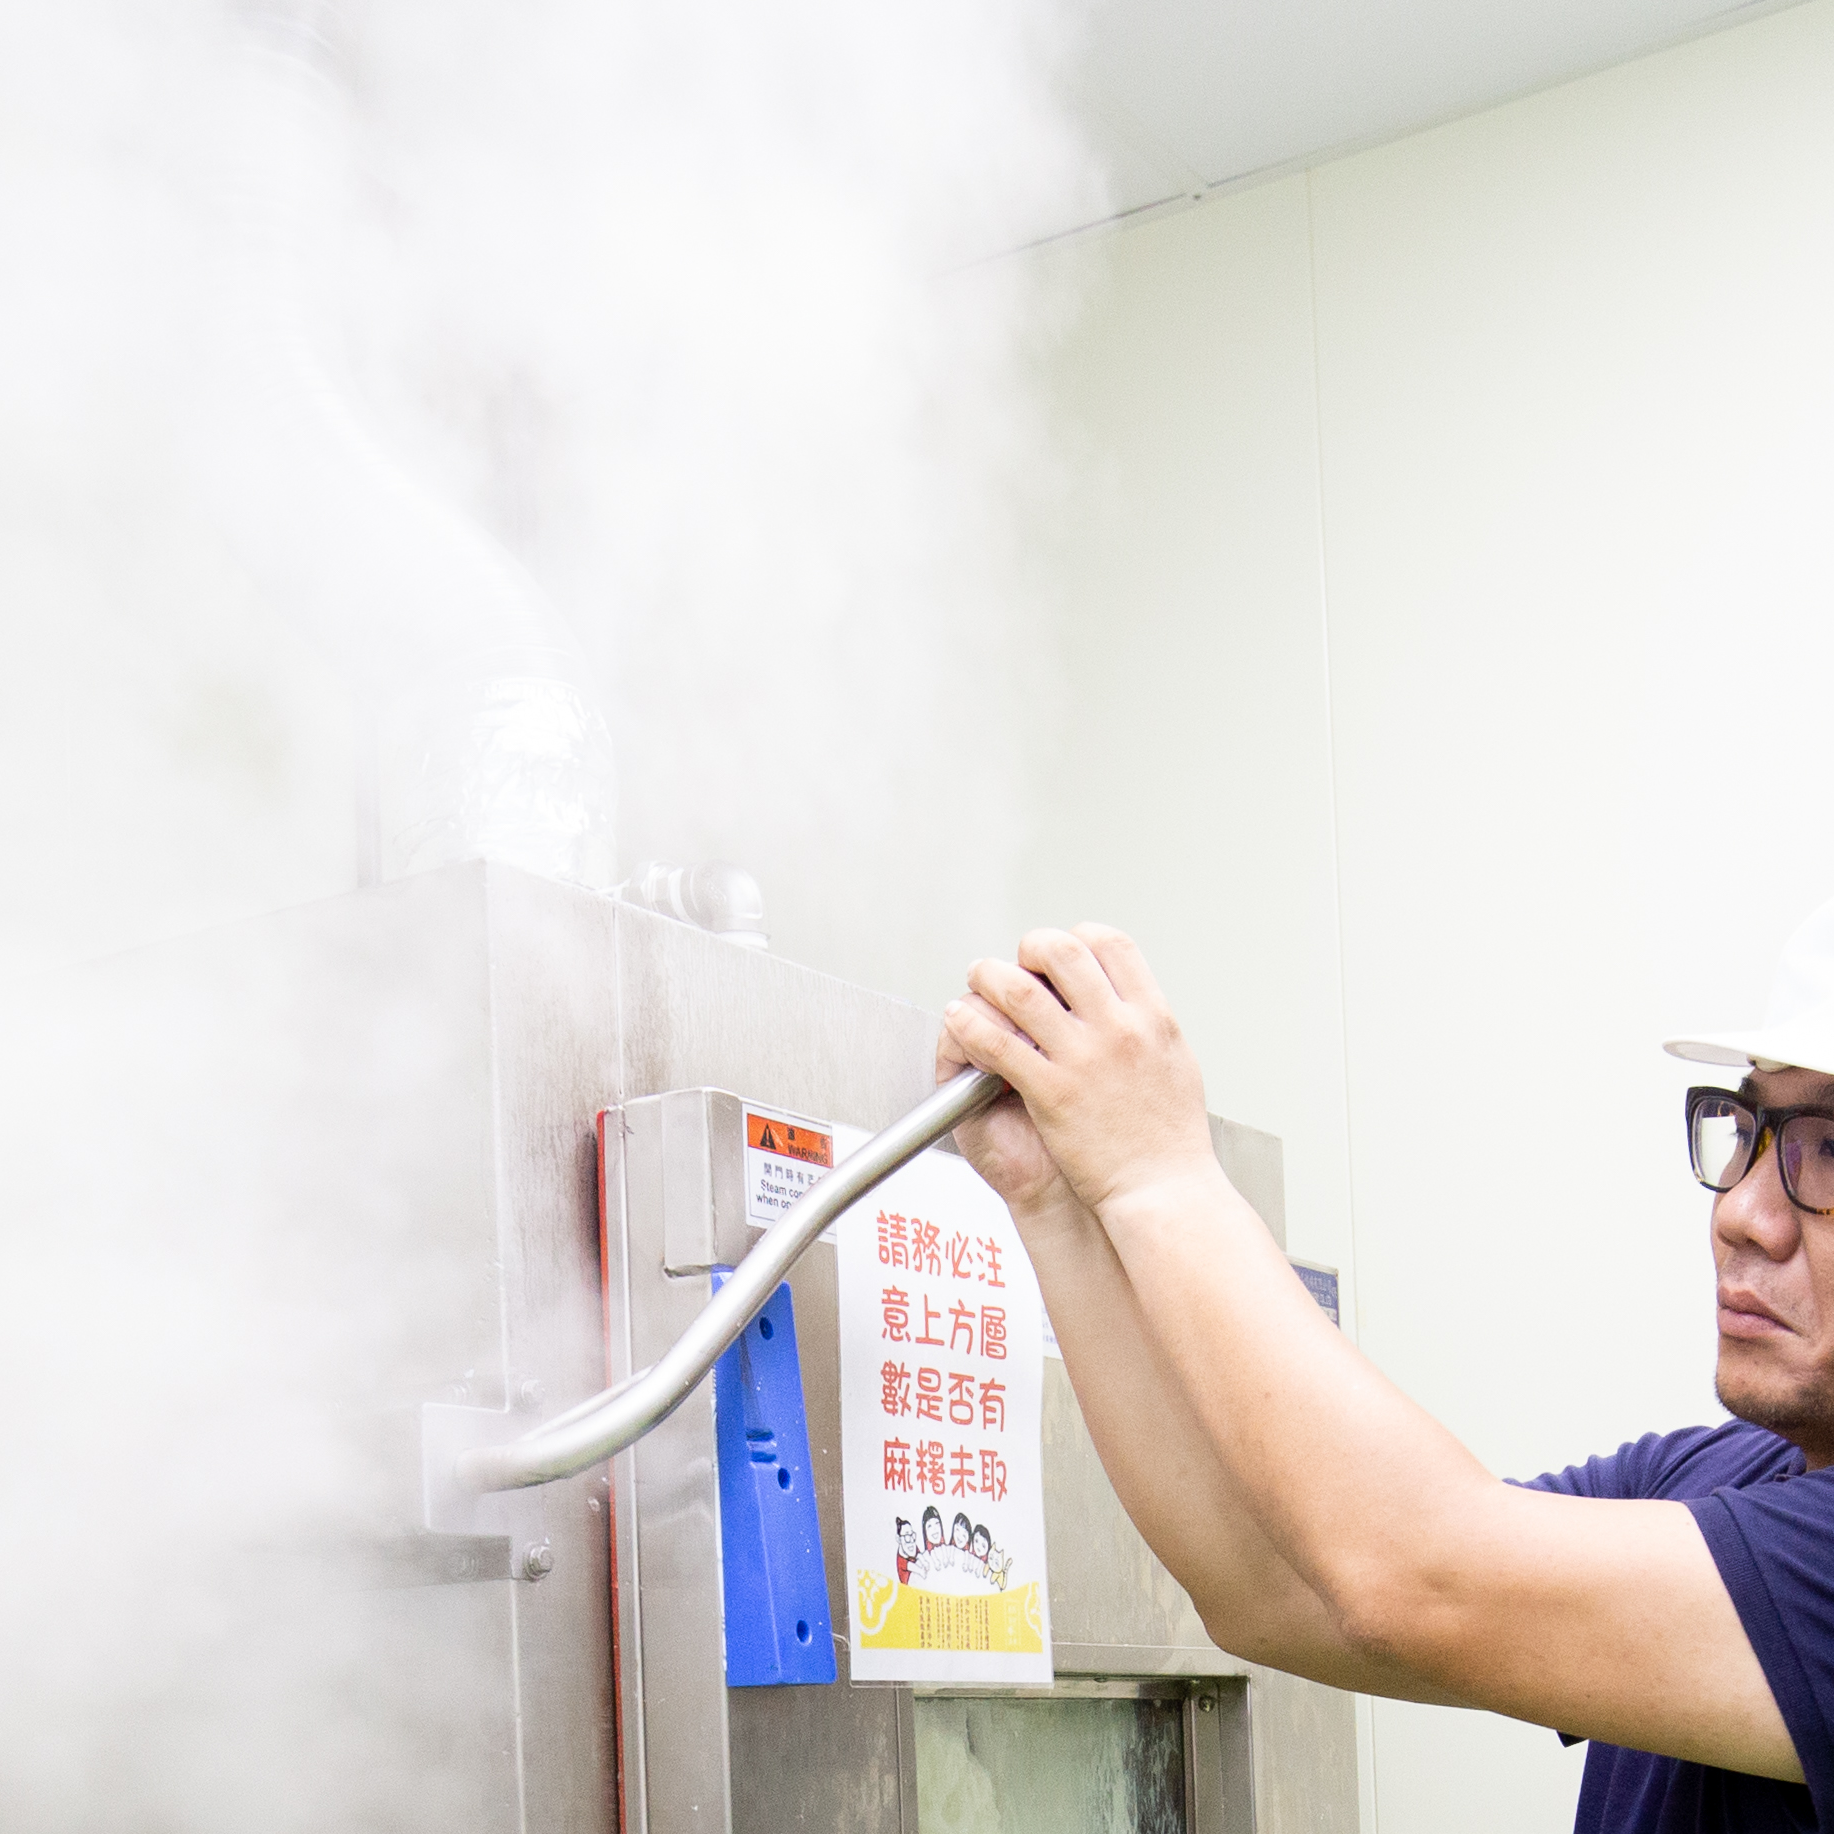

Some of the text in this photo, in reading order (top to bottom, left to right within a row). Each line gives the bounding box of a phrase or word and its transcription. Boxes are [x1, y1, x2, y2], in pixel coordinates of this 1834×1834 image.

[787, 1143, 828, 1165] WARNING
[755, 1192, 779, 1208] when
[760, 1178, 787, 1197] Steam
[876, 1209, 1006, 1289] 請務必注
[881, 1285, 1007, 1360] 意上方層
[880, 1359, 1007, 1433] 數是否有
[883, 1436, 1008, 1502] 麻糬未取
